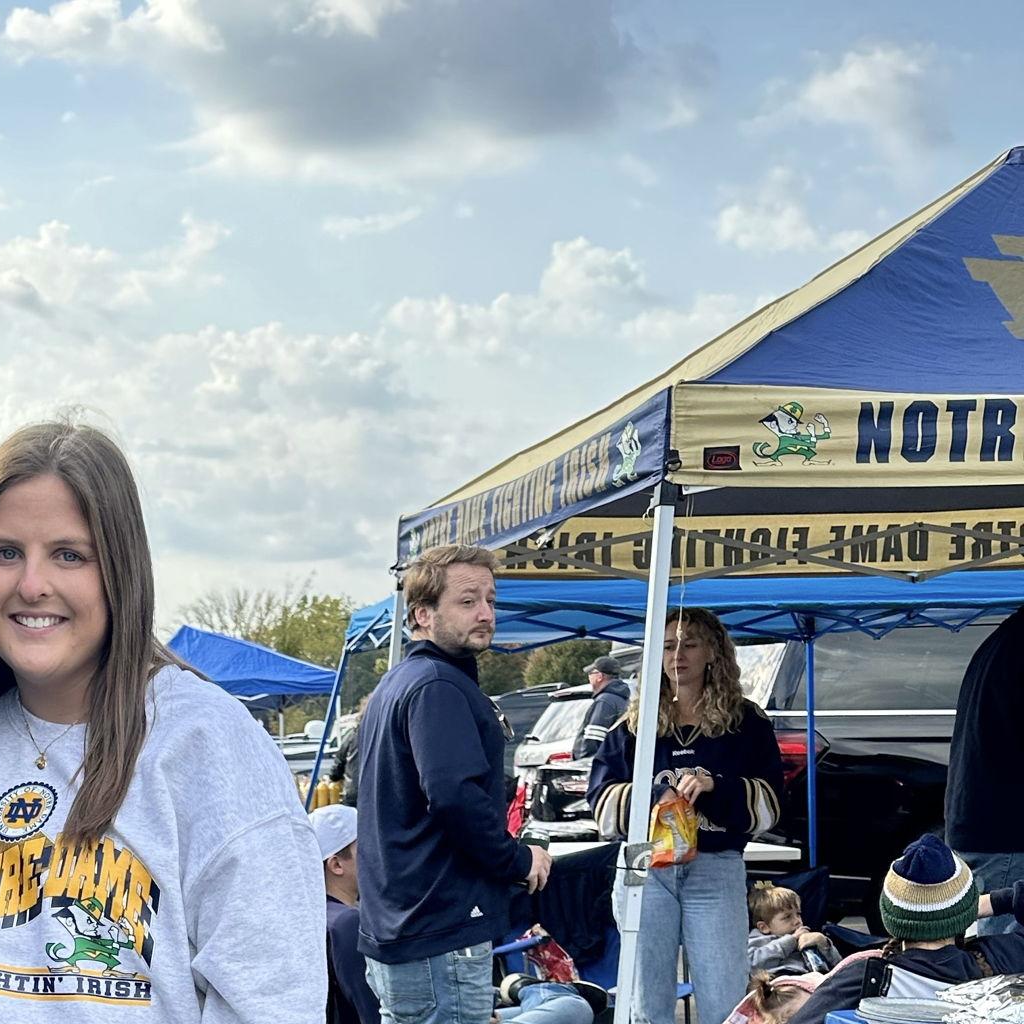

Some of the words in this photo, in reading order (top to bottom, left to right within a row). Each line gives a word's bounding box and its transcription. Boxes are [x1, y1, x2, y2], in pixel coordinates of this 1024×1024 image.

[856, 398, 1024, 464] NOTR
[490, 460, 556, 536] FIGHTING
[560, 432, 611, 508] IRISH
[672, 749, 695, 757] Reebok
[77, 976, 152, 999] IRISH
